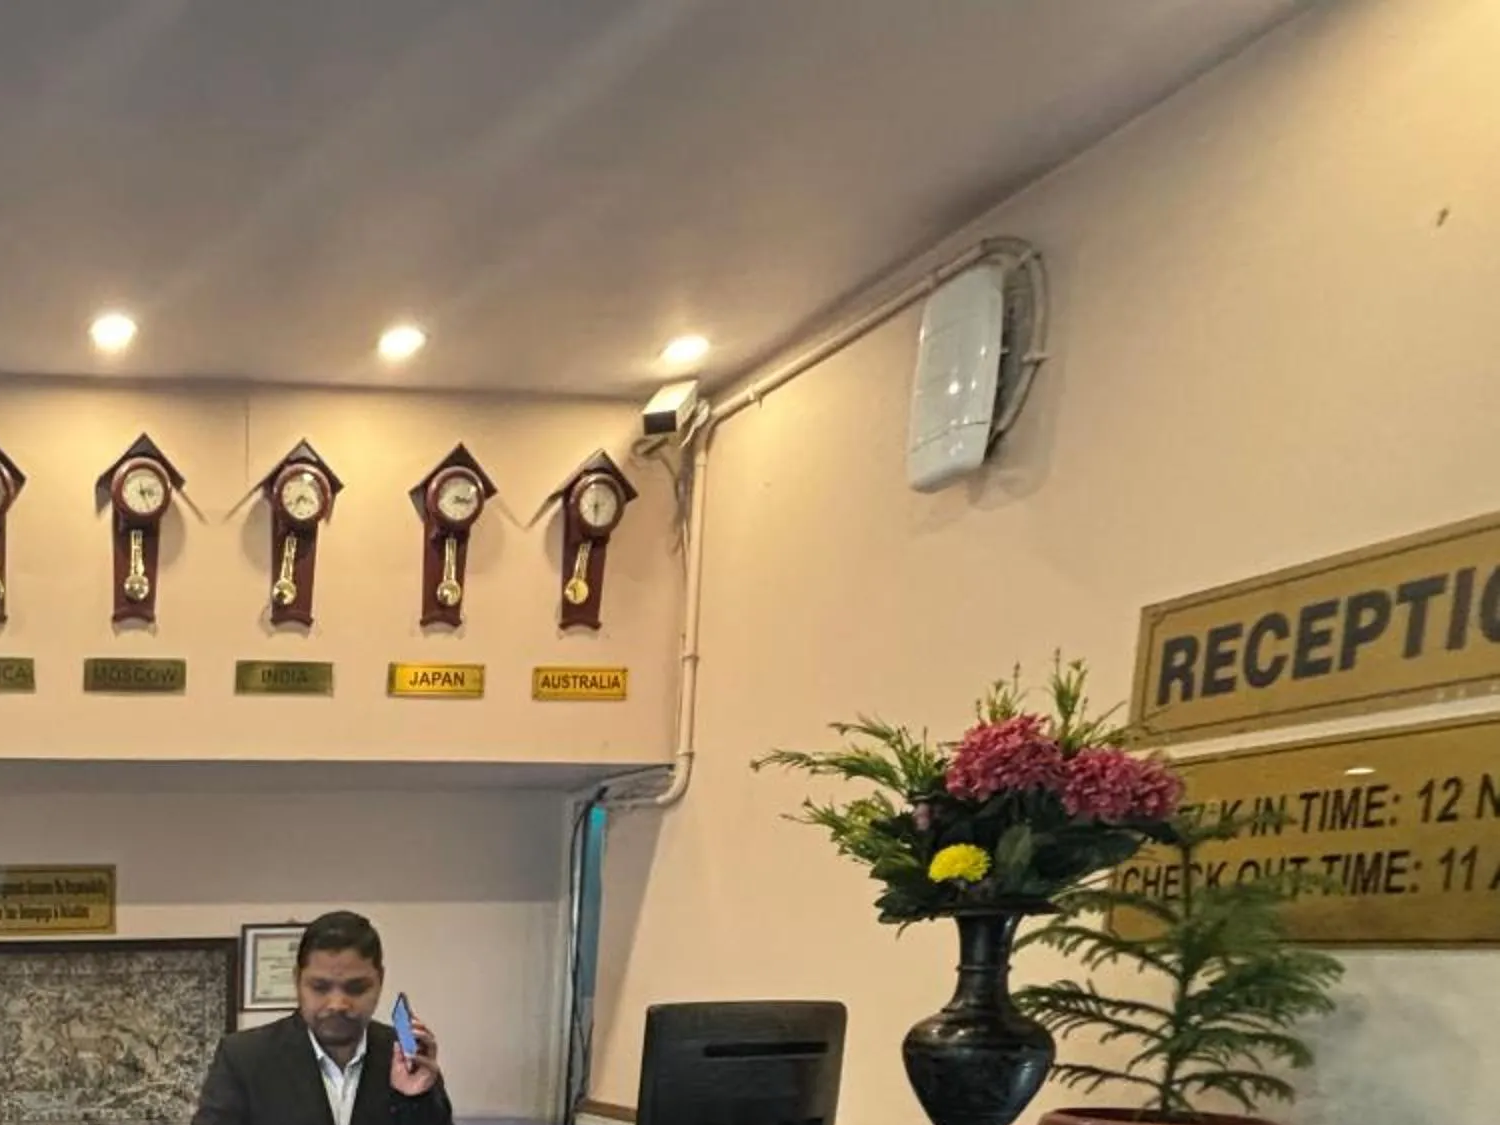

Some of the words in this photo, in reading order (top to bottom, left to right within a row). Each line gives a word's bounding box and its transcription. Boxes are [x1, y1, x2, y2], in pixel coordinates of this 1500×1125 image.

[93, 665, 176, 683] MOSCOW
[261, 668, 309, 684] INDIA
[409, 671, 465, 688] JAPAN
[541, 674, 621, 690] AUSTRALIA
[1299, 783, 1404, 834] TIME:
[1417, 775, 1463, 824] 12
[1320, 849, 1423, 897] TIME:
[1438, 845, 1479, 892] 11
